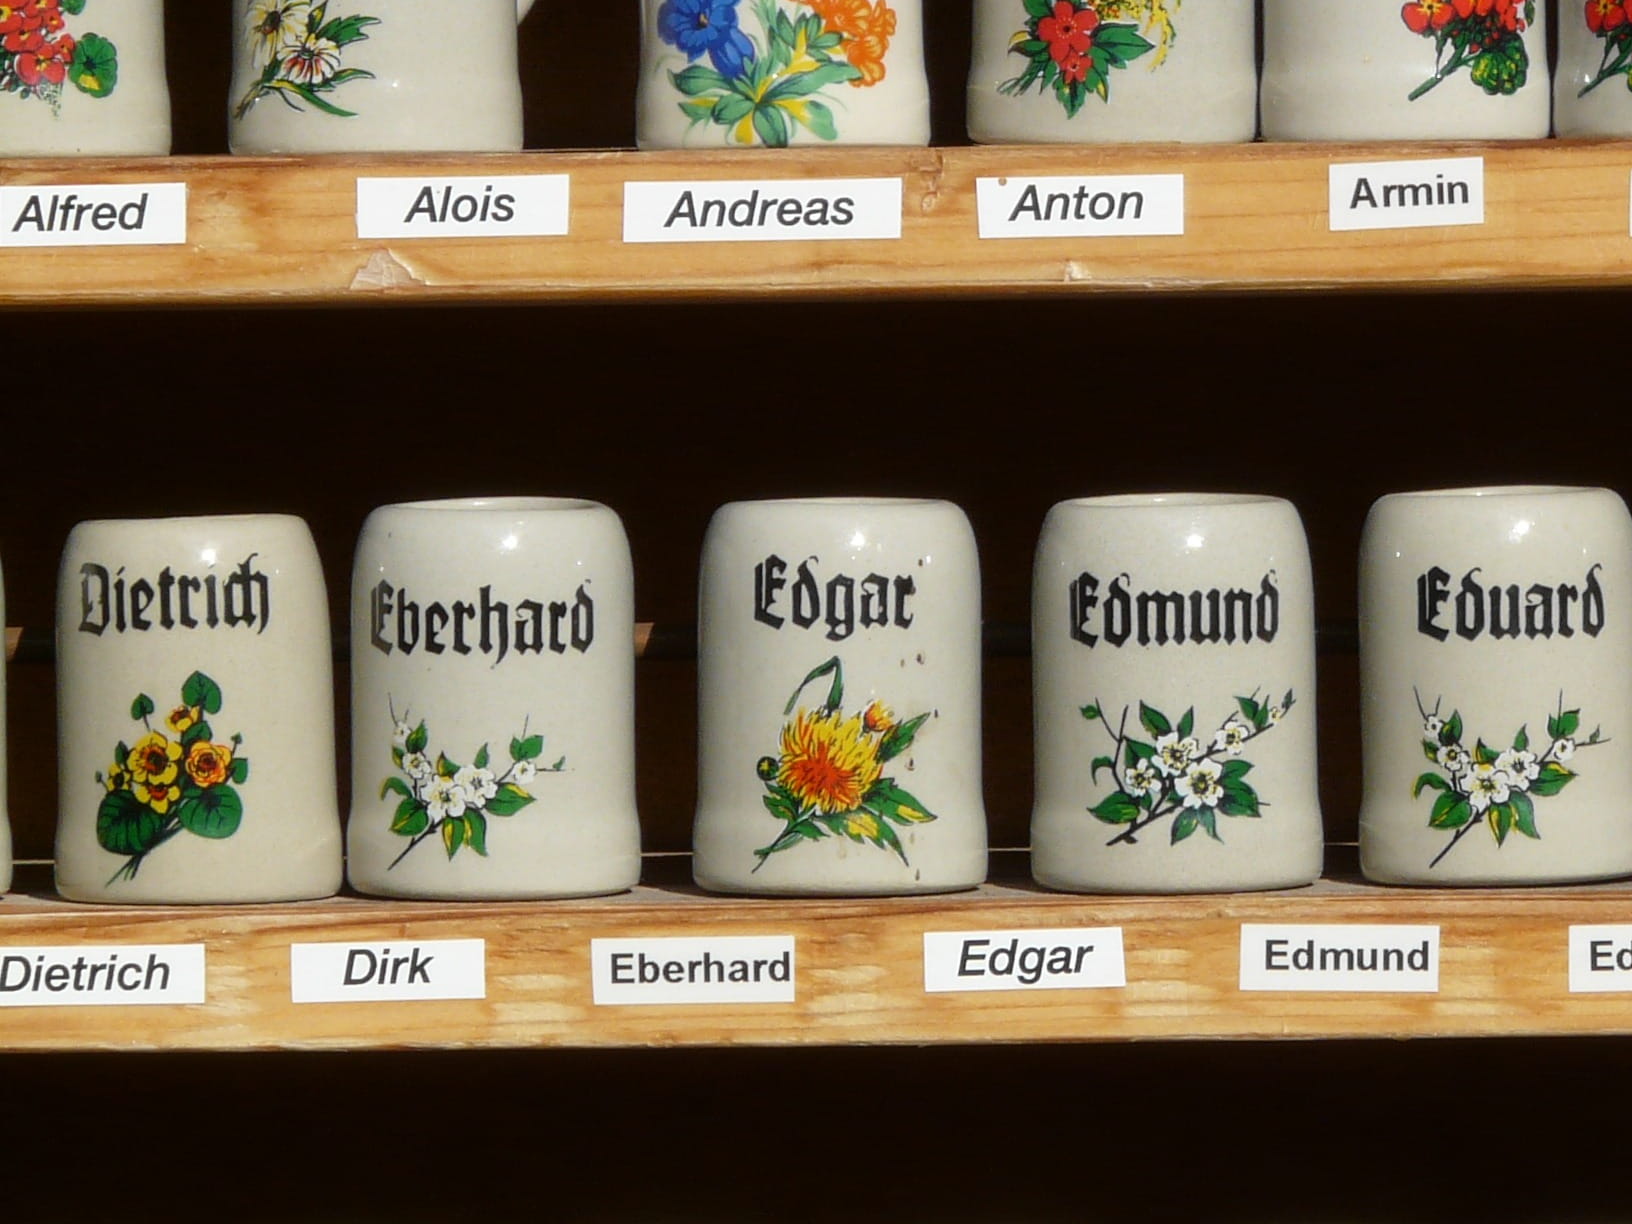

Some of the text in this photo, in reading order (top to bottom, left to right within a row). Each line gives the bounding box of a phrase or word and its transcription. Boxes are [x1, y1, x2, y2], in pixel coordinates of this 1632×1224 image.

[404, 185, 515, 222] Alois
[664, 190, 854, 227] Andreas
[1009, 185, 1143, 221] Anton
[1350, 174, 1468, 208] Armin
[12, 193, 148, 231] Alfred
[77, 553, 269, 639] Dietrich
[754, 554, 915, 641] Edgar
[1069, 567, 1278, 649] Edmund
[1417, 564, 1604, 642] Eduard
[370, 579, 593, 664] Eberhard
[0, 954, 169, 991] Dietrich
[342, 945, 433, 985] Dirk
[611, 952, 790, 983] Eberhard
[958, 939, 1093, 984] Edgar
[1266, 940, 1428, 971] Edmund
